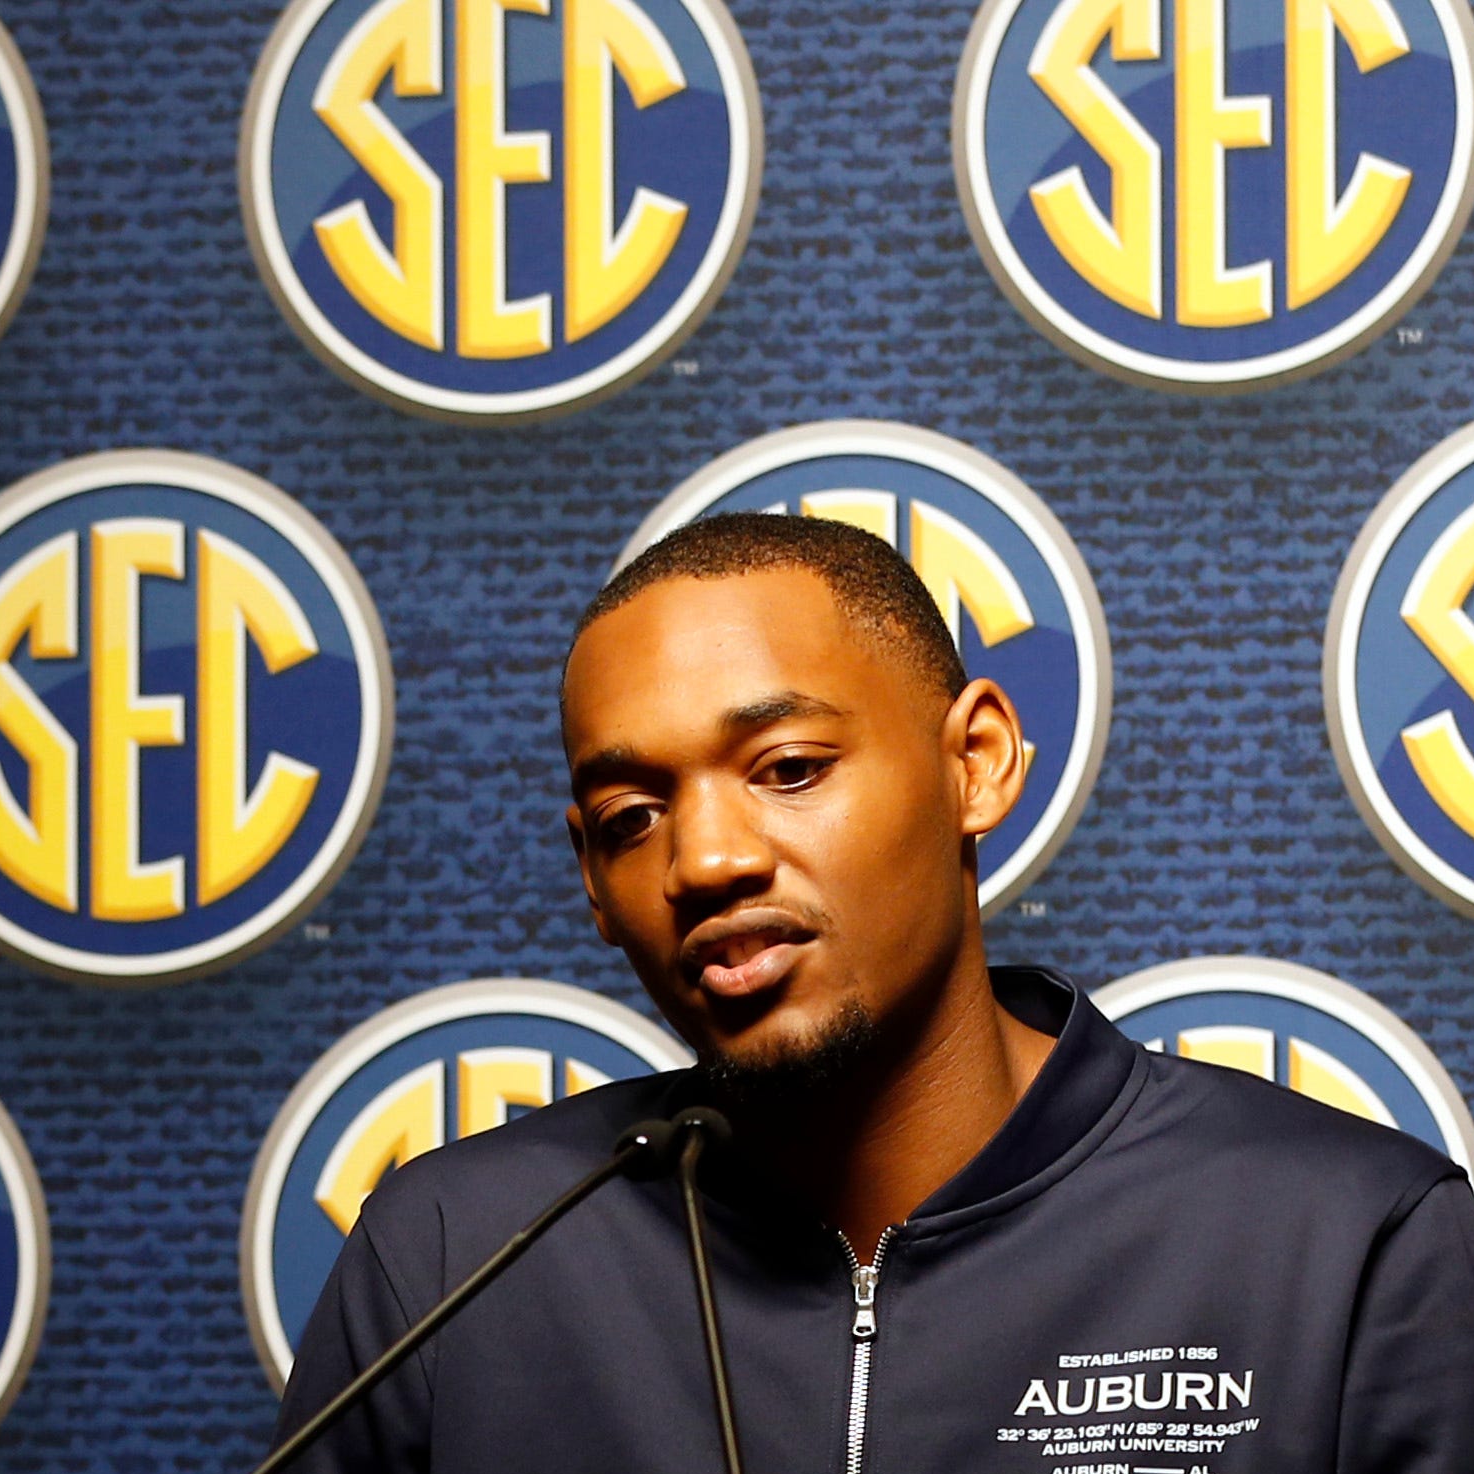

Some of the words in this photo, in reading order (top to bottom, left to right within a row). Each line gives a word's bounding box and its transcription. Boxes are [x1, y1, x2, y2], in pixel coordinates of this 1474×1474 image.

[313, 0, 688, 360] SEC
[1028, 0, 1413, 327] SEC
[1397, 327, 1423, 346] TM
[1058, 1346, 1175, 1369] ESTABLISHED
[1177, 1346, 1219, 1360] 1856
[1013, 1369, 1254, 1416] AUBURN
[1041, 1438, 1117, 1456] AUBURN
[1119, 1438, 1226, 1453] UNIVERSITY
